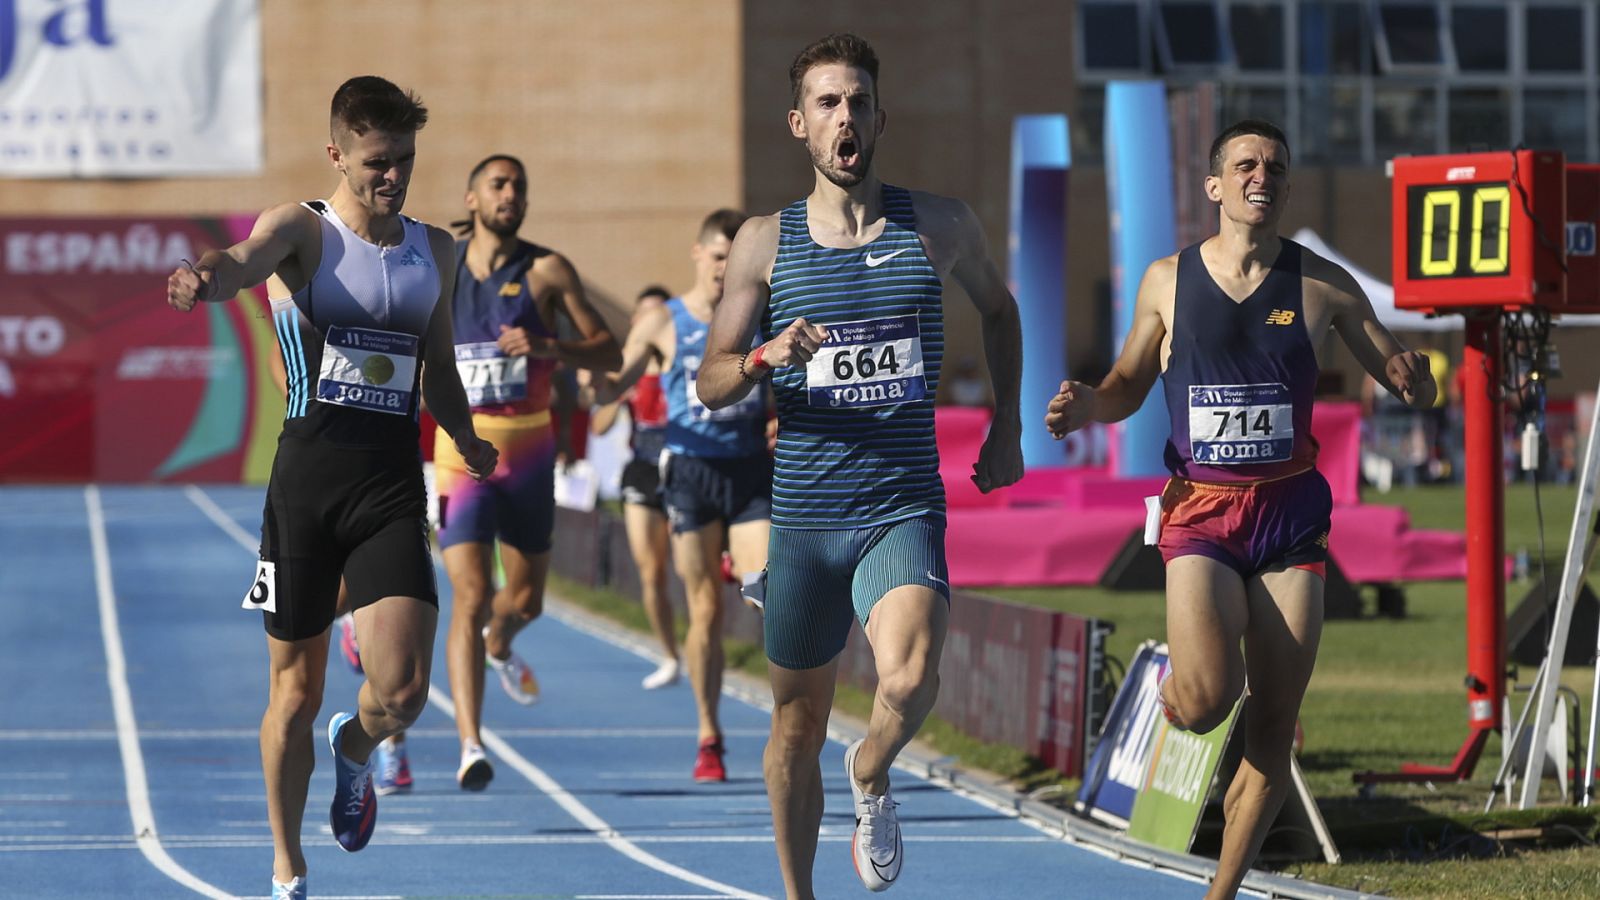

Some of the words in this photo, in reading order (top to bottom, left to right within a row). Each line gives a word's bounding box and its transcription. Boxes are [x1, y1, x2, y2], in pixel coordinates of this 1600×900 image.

[7, 223, 194, 274] ESPAÑA
[1421, 187, 1510, 276] 00
[842, 325, 875, 335] Diputación
[467, 361, 508, 383] 717
[833, 345, 900, 381] 664
[1213, 409, 1273, 437] 714
[249, 567, 269, 604] 6
